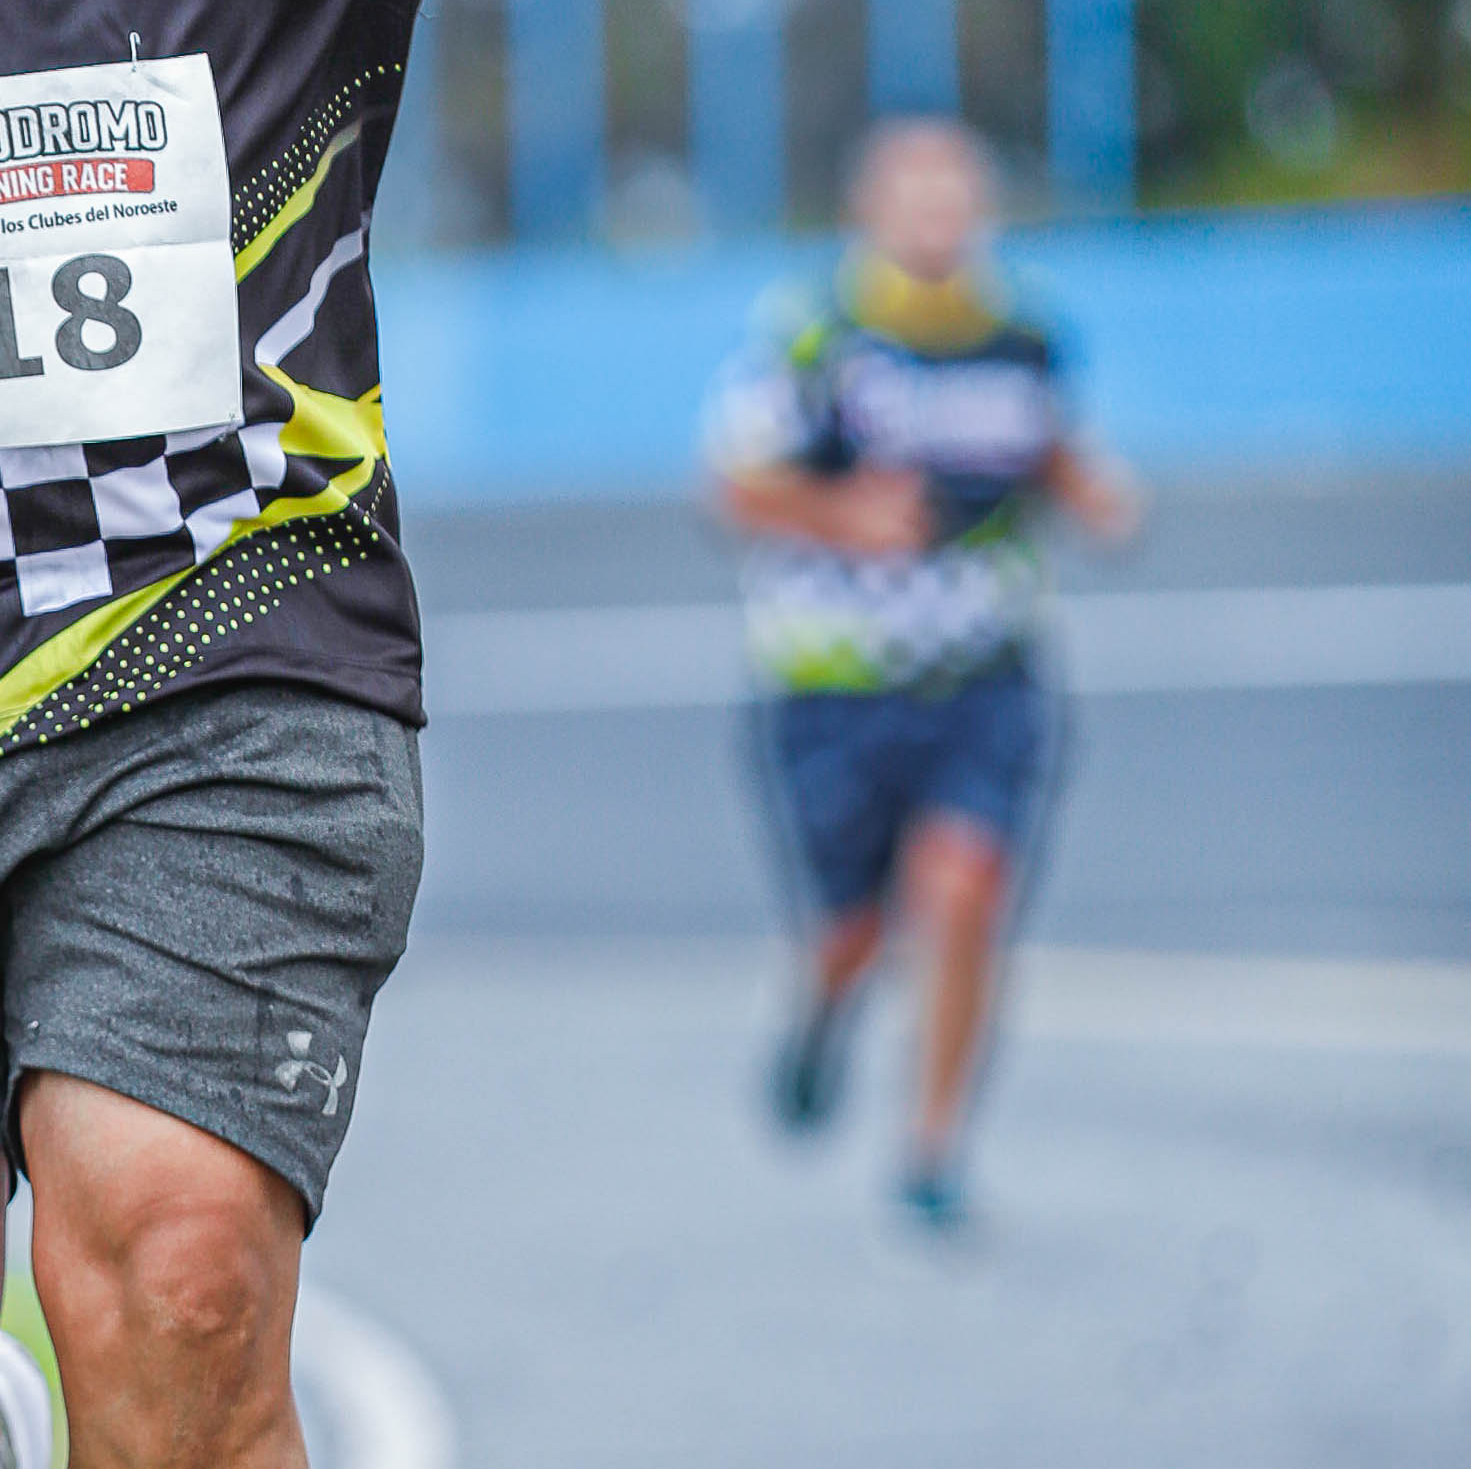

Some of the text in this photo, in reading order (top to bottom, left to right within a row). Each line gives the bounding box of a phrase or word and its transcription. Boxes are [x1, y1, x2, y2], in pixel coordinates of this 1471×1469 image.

[62, 161, 129, 193] RACE
[1, 218, 25, 234] los
[28, 211, 82, 230] Clubes
[85, 204, 110, 222] del
[113, 199, 178, 219] Noroeste
